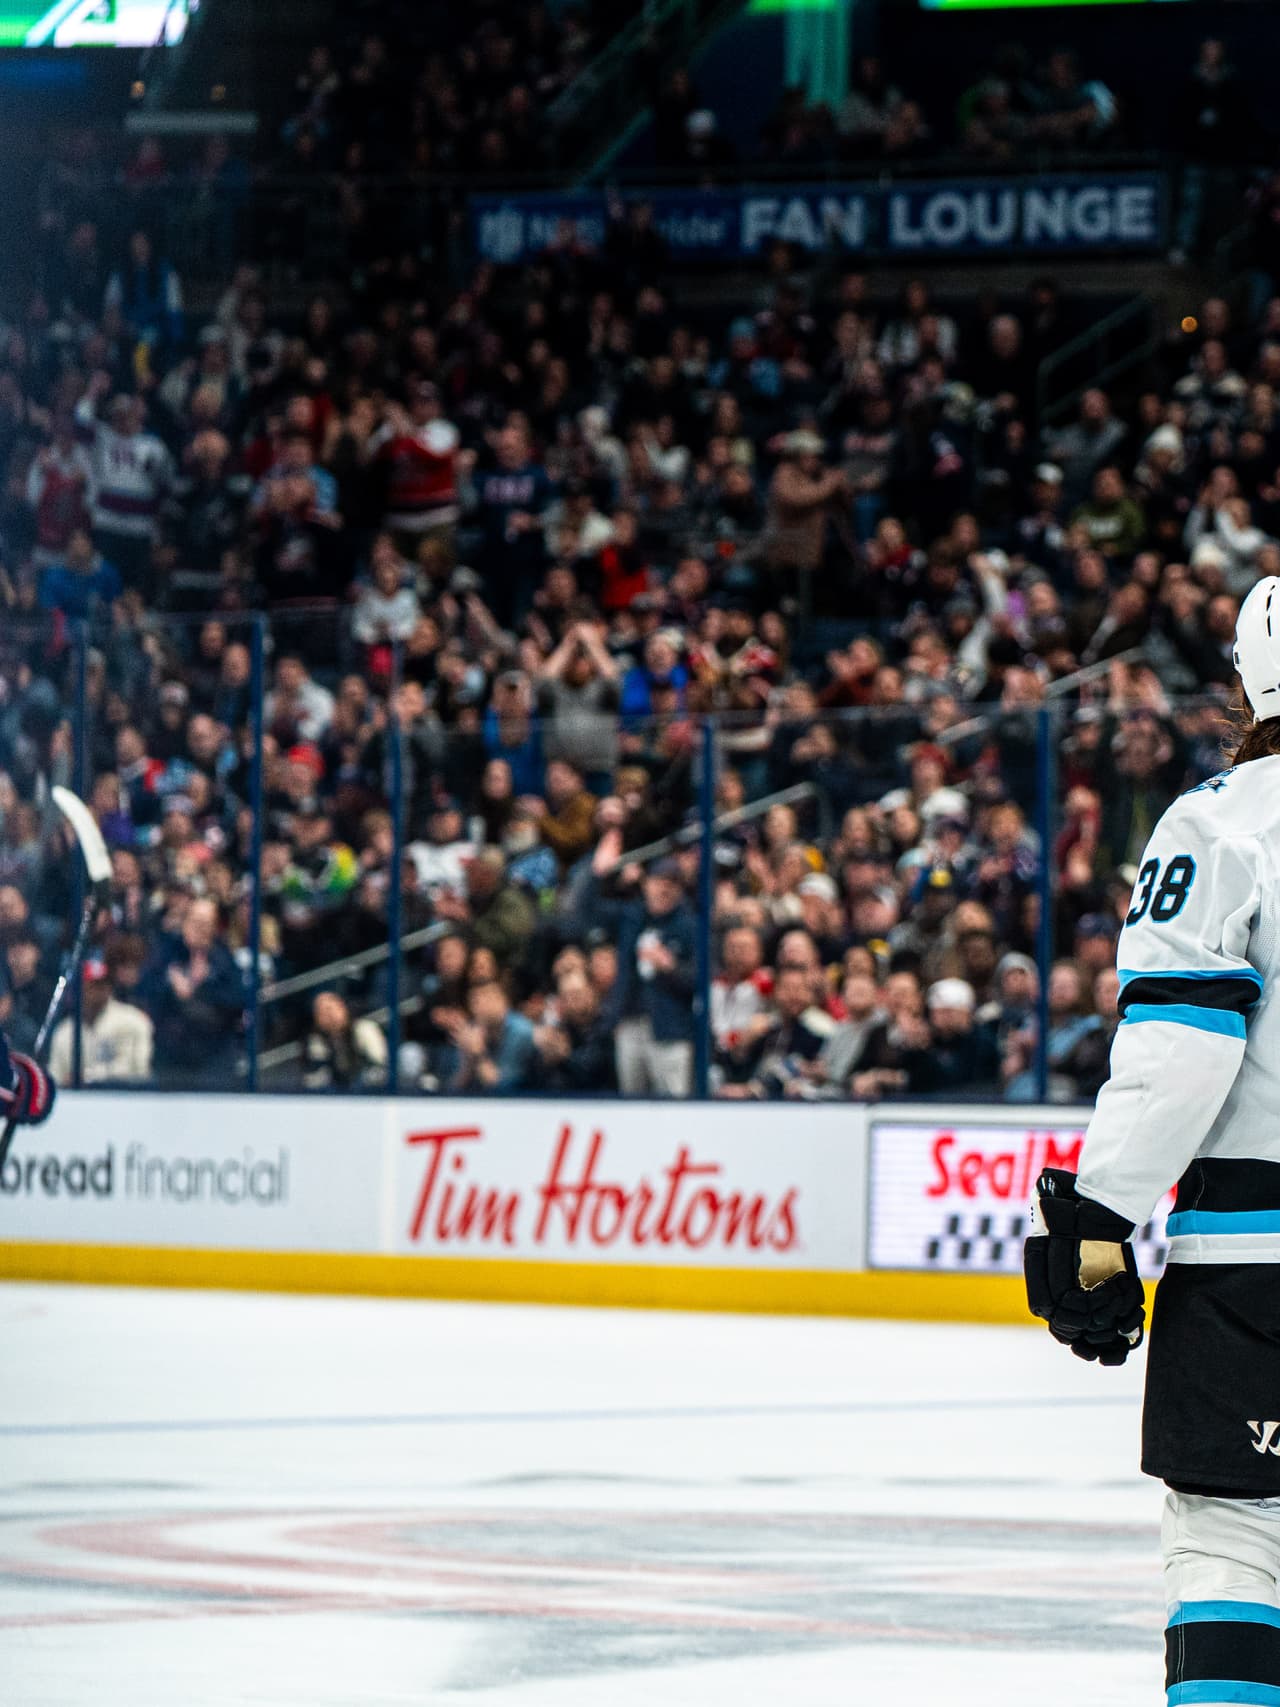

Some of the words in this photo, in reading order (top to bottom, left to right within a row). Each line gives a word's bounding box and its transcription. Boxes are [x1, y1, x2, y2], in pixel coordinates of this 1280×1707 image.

[742, 198, 863, 250] FAN
[890, 186, 1155, 246] LOUNGE
[1125, 854, 1197, 927] 38
[124, 1142, 290, 1204] financial
[404, 1126, 522, 1247] Tim
[535, 1121, 801, 1253] Hortons
